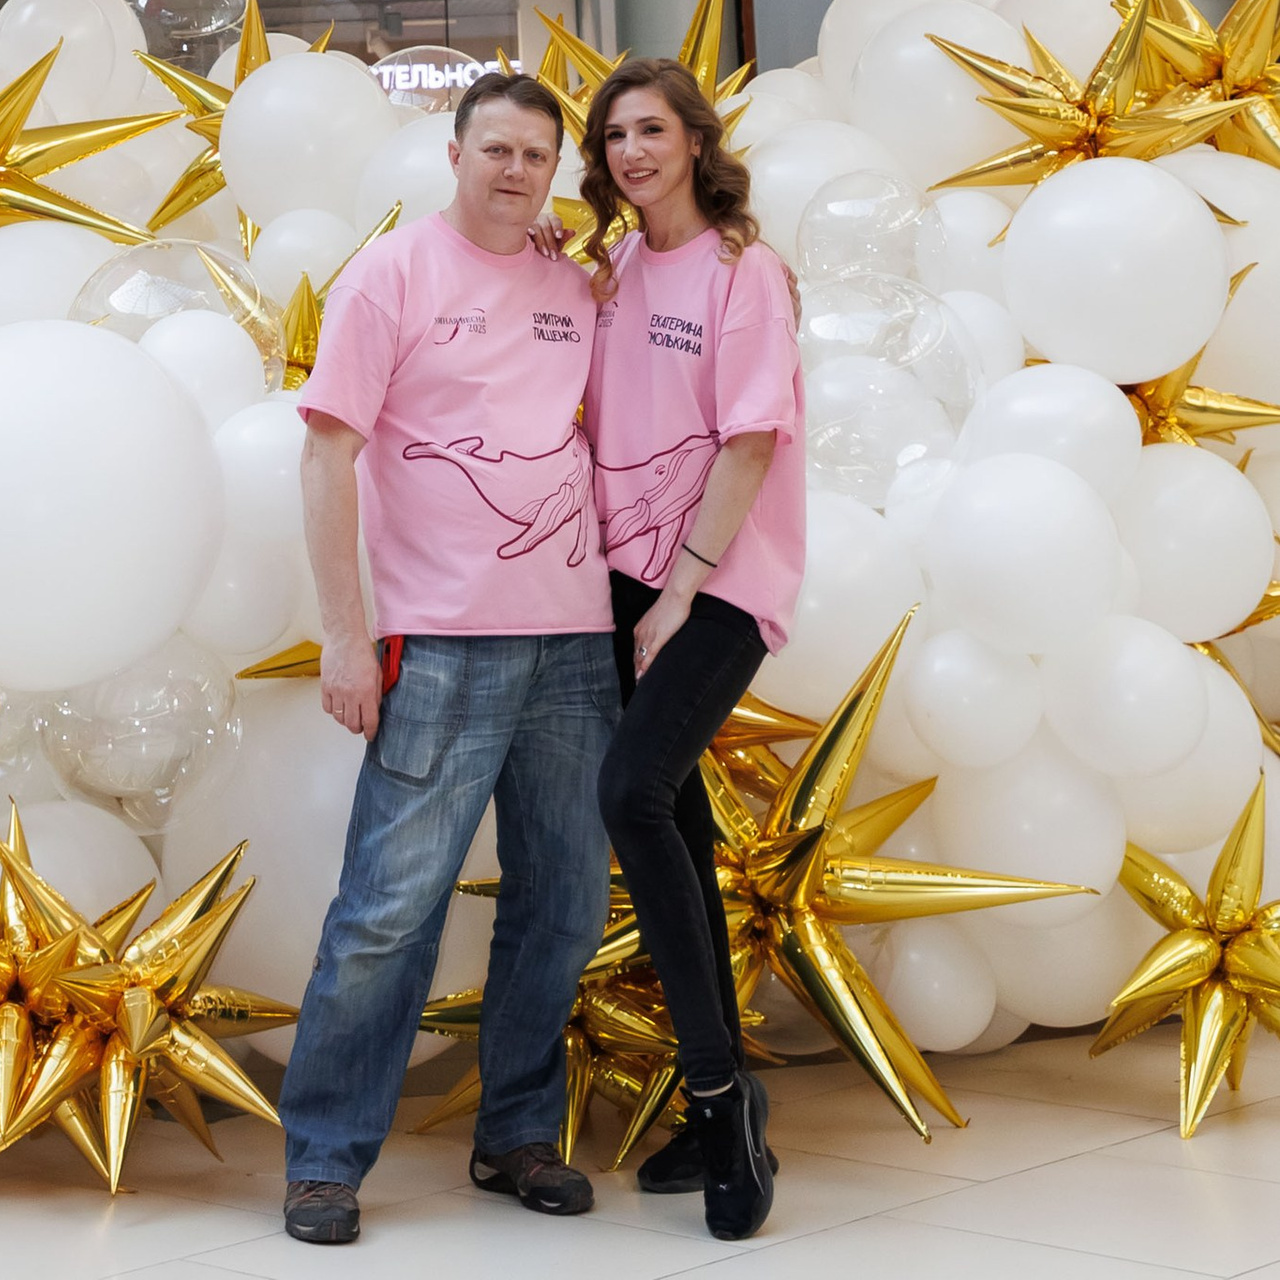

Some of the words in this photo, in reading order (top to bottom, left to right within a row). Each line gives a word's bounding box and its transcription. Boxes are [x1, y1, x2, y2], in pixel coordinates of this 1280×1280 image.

[532, 312, 574, 328] ДМИТРИЙ
[649, 314, 703, 338] ЕКАТЕРИНА
[467, 324, 487, 335] 2025
[532, 326, 581, 343] ТИЩЕНКО
